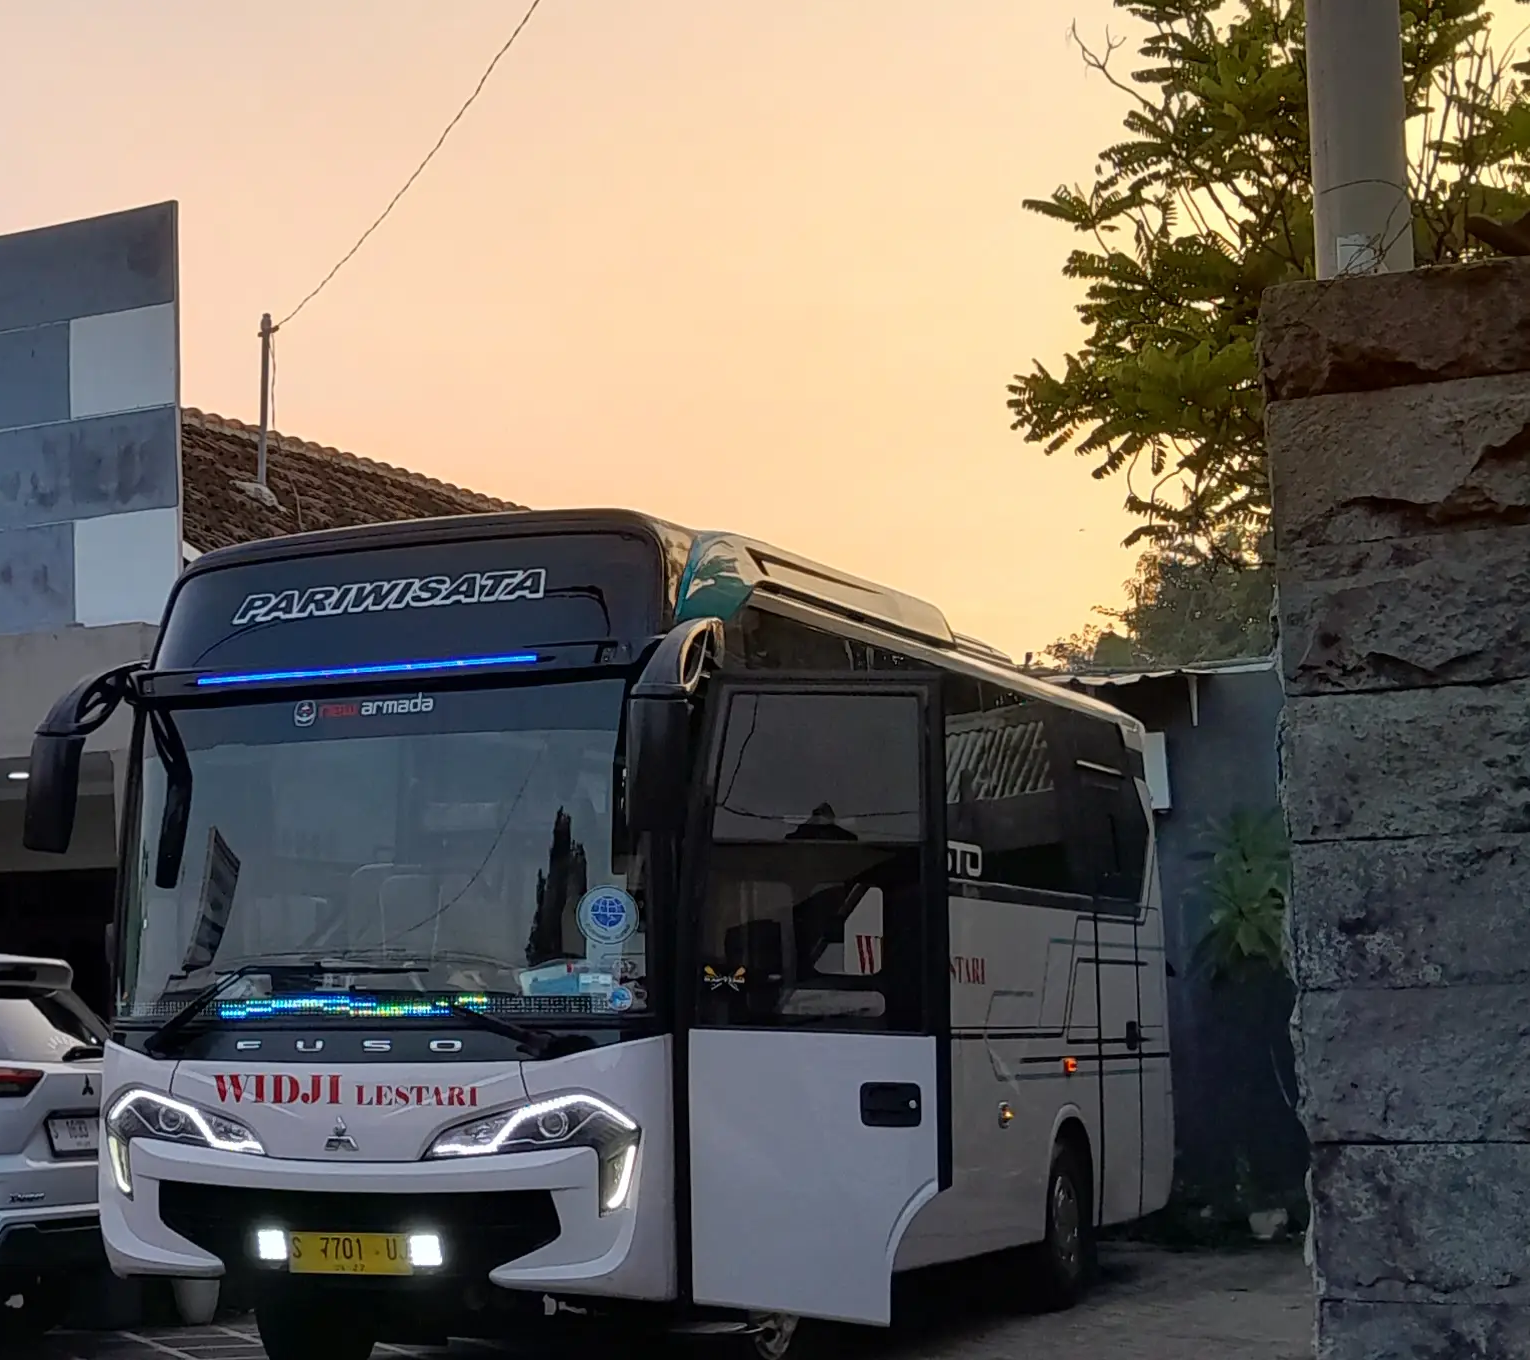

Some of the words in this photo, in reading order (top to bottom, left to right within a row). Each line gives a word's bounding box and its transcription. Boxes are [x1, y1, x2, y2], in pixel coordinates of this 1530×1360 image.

[232, 568, 546, 625] PARIWISATA
[360, 691, 434, 716] armada
[236, 1039, 463, 1053] FUSO
[213, 1073, 344, 1106] WIDJI
[355, 1084, 479, 1107] LESTARI
[292, 1236, 303, 1259] S
[319, 1236, 364, 1261] 7701
